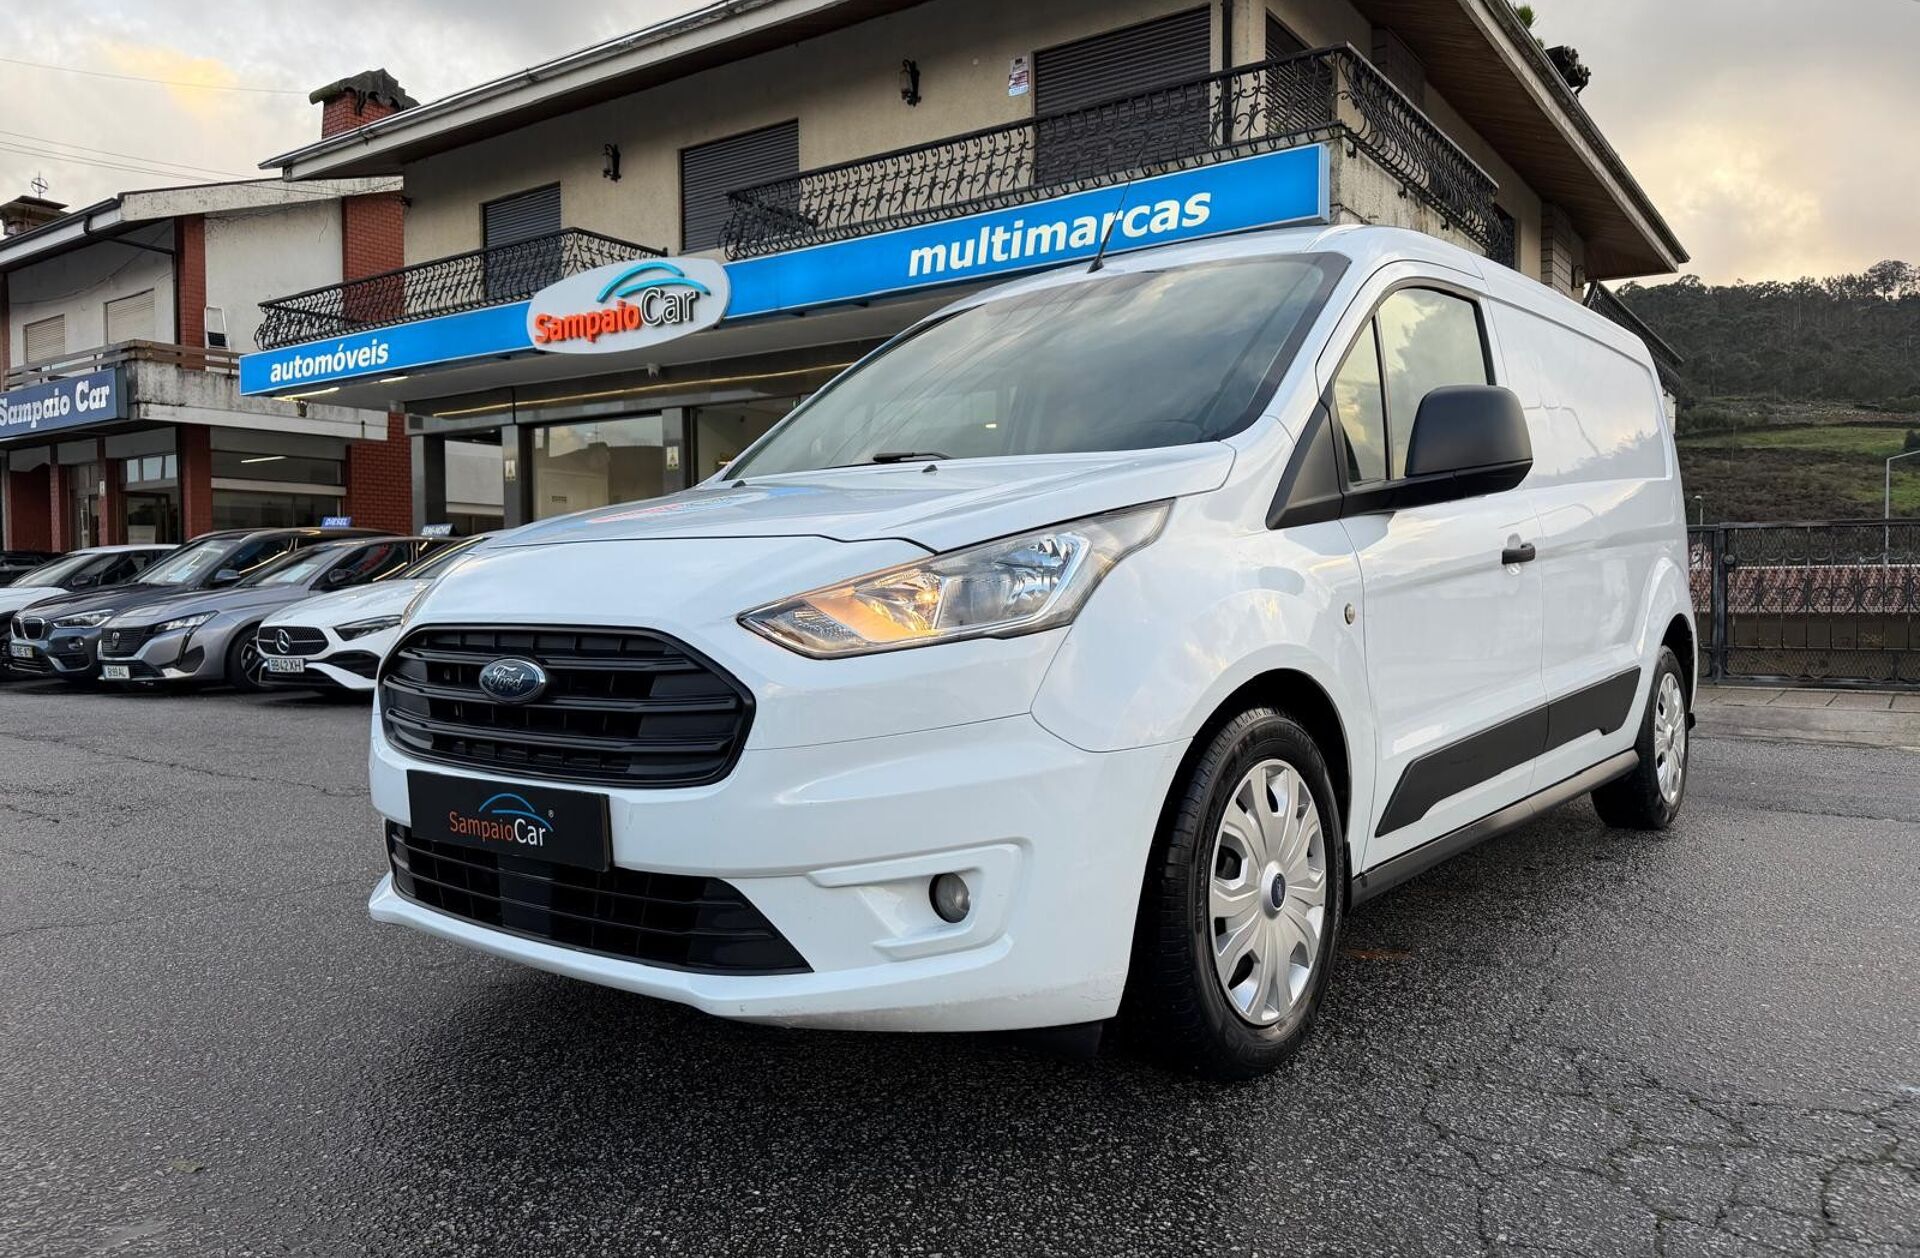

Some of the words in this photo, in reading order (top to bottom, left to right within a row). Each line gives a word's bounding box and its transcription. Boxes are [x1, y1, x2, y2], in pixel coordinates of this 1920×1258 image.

[908, 191, 1212, 278] multimarcas
[270, 339, 389, 383] automóveis
[0, 388, 71, 429] Sampaio
[75, 379, 110, 413] Car
[490, 664, 525, 690] Ford
